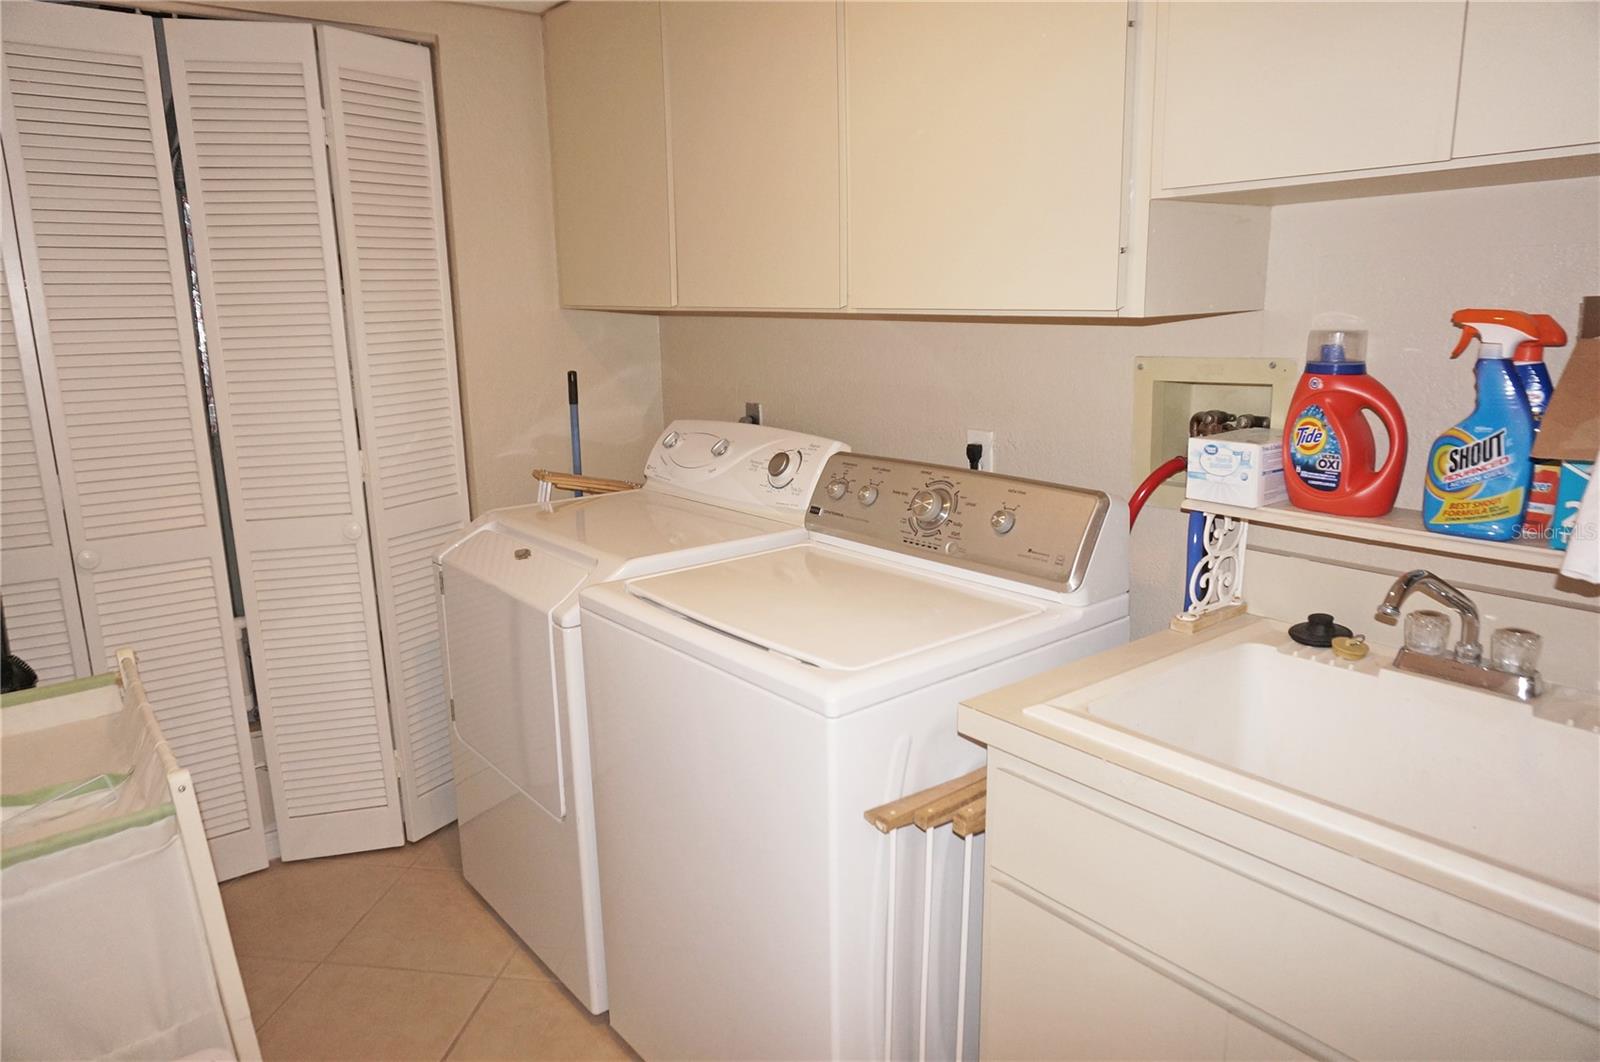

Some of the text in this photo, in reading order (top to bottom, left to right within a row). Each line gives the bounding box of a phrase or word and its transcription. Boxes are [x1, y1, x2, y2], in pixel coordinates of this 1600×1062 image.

[1296, 427, 1323, 446] Tide
[1448, 430, 1505, 473] SHOUT
[1318, 459, 1340, 470] OXI
[1449, 501, 1471, 510] BEST
